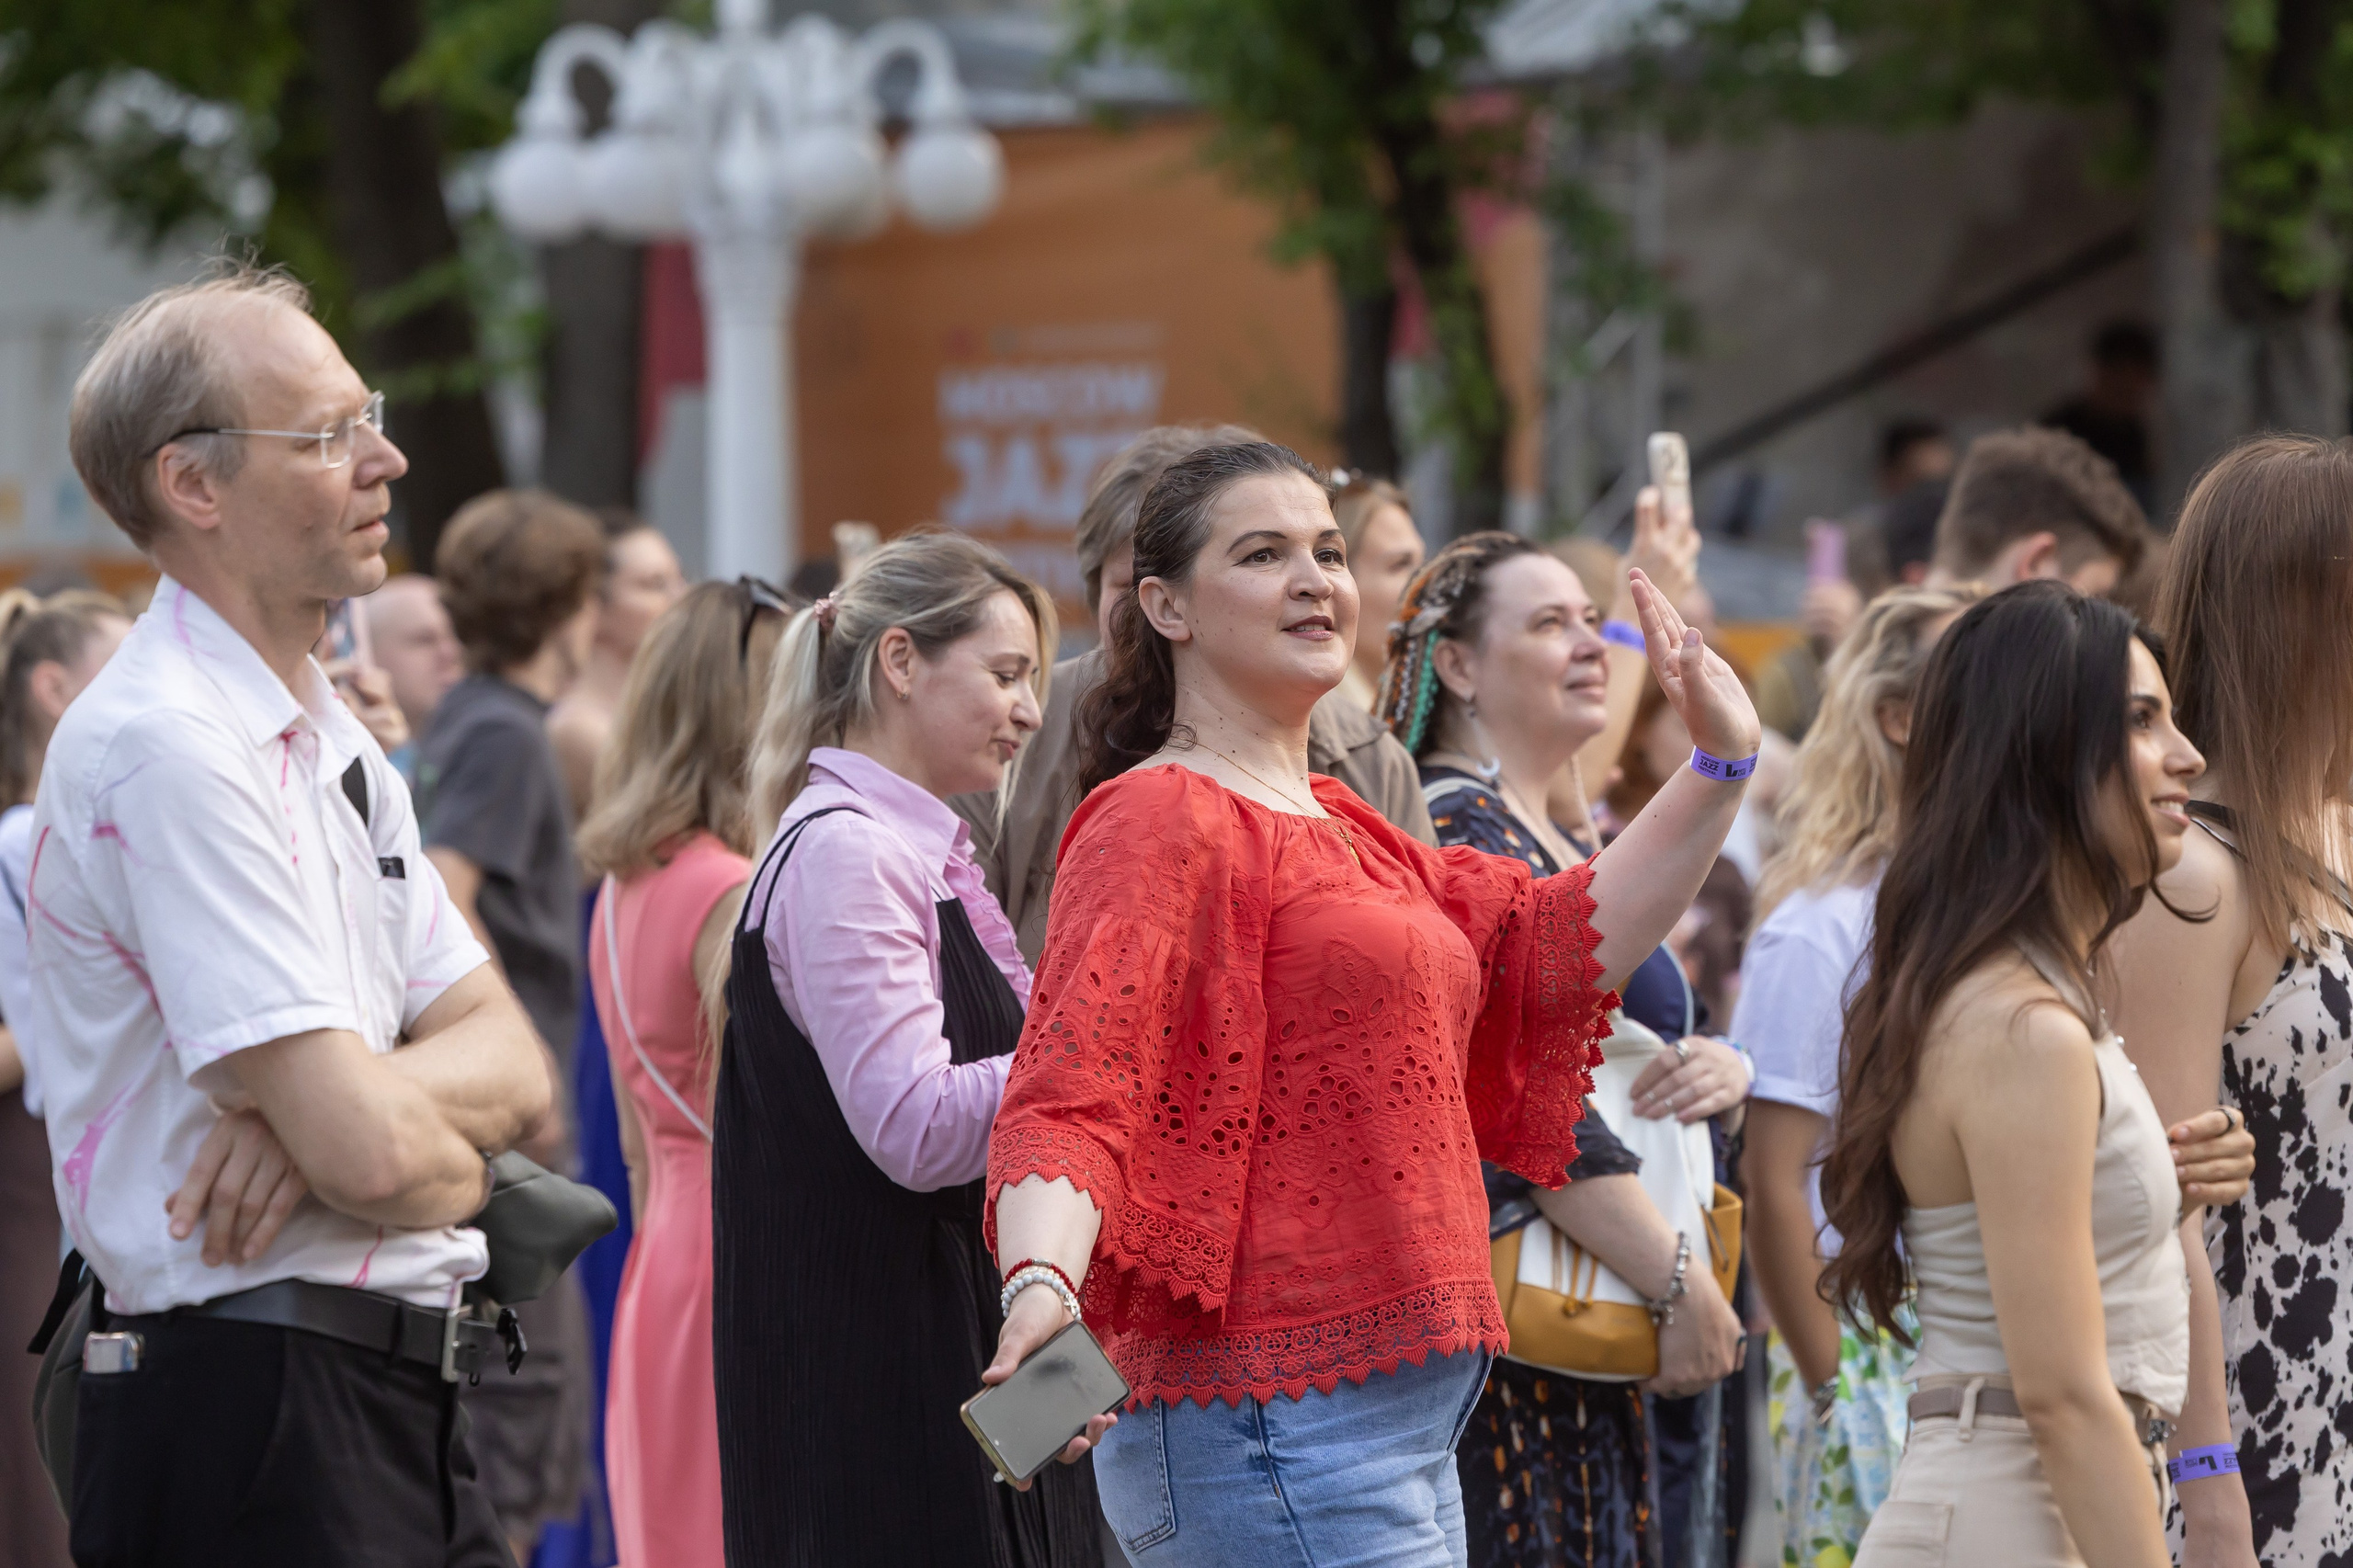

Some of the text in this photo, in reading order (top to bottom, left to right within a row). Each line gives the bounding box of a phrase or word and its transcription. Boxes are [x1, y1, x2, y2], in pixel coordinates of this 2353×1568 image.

[1699, 758, 1719, 772] JAZZ
[1700, 756, 1720, 765] MOSCOW
[1699, 765, 1716, 775] FESTIVAL
